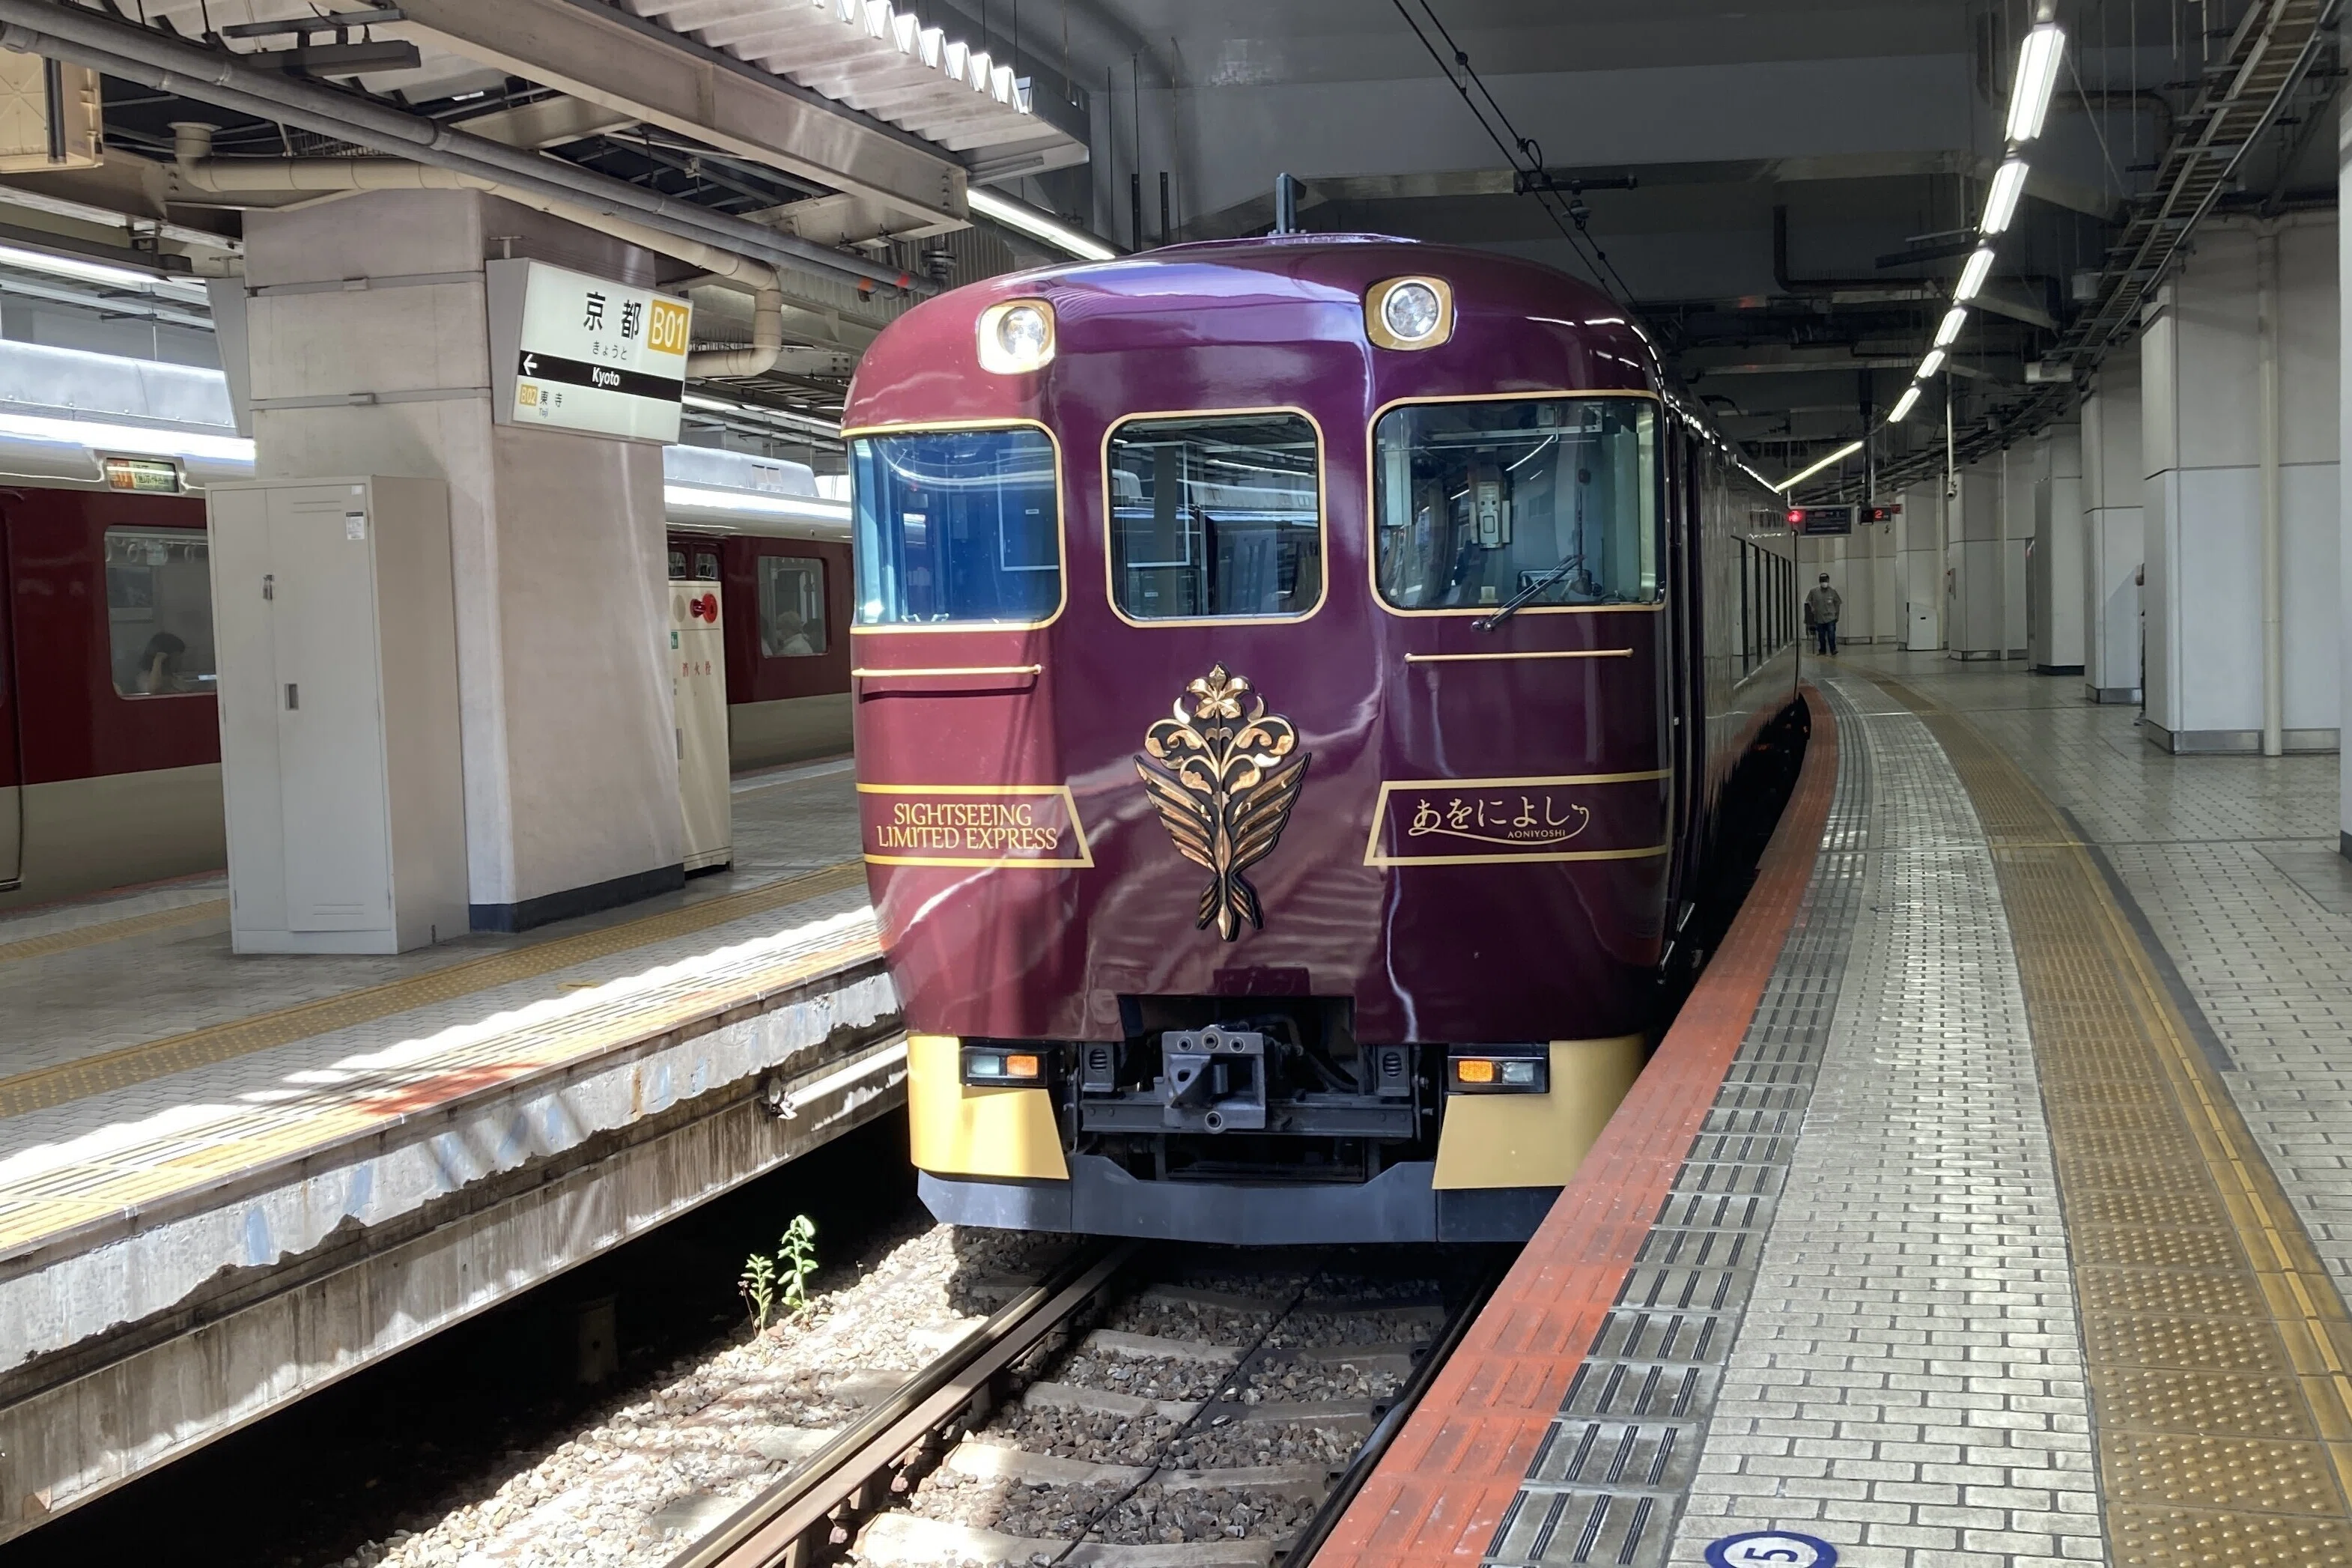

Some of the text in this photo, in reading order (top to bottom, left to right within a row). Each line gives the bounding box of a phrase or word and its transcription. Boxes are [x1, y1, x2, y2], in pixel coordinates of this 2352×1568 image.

[583, 291, 642, 340] 京都
[651, 306, 684, 350] B01
[592, 341, 627, 360] きょうと
[592, 366, 620, 387] Kyoto
[521, 386, 536, 404] B02
[540, 390, 562, 408] 東寺
[893, 803, 1032, 826] SIGHTSEEING
[876, 825, 1058, 850] LIMITED EXPRESS
[1507, 829, 1566, 839] AONIYOSHI
[1743, 1547, 1799, 1563] 5
